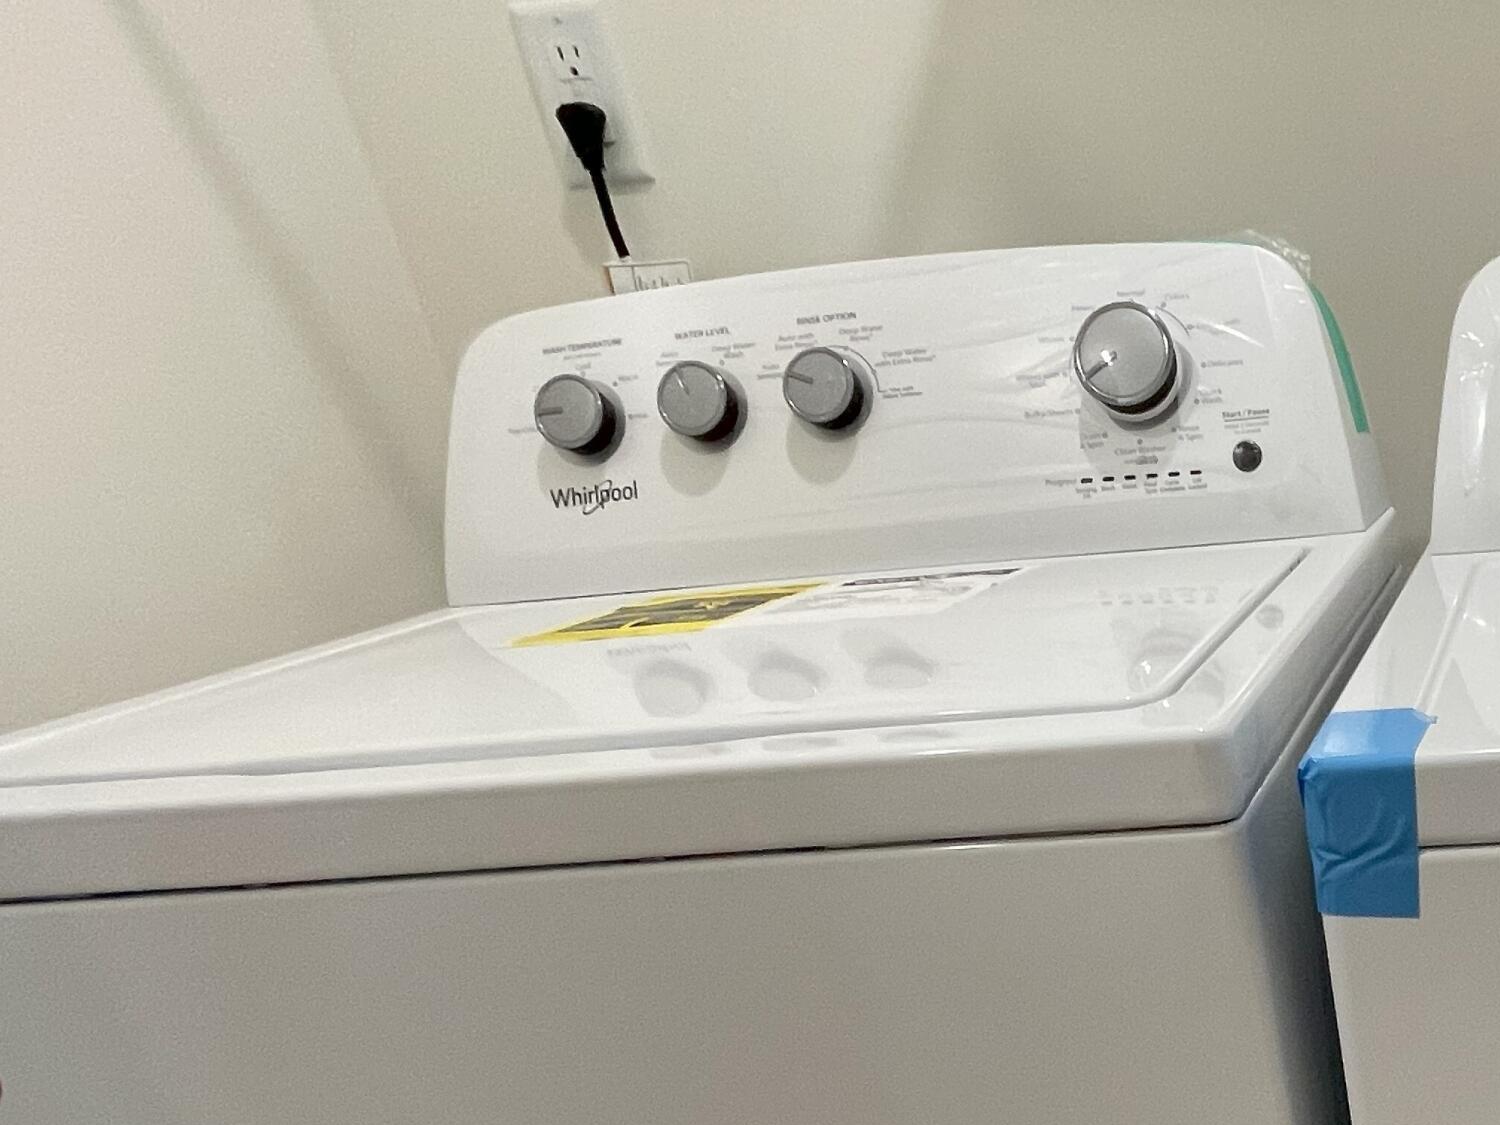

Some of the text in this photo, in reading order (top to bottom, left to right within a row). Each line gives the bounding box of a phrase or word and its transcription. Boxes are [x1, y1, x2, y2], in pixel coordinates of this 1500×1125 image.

[822, 311, 857, 324] OPTION
[705, 326, 730, 338] LEVEL
[1222, 409, 1241, 419] Start
[549, 479, 638, 515] Whirlpool
